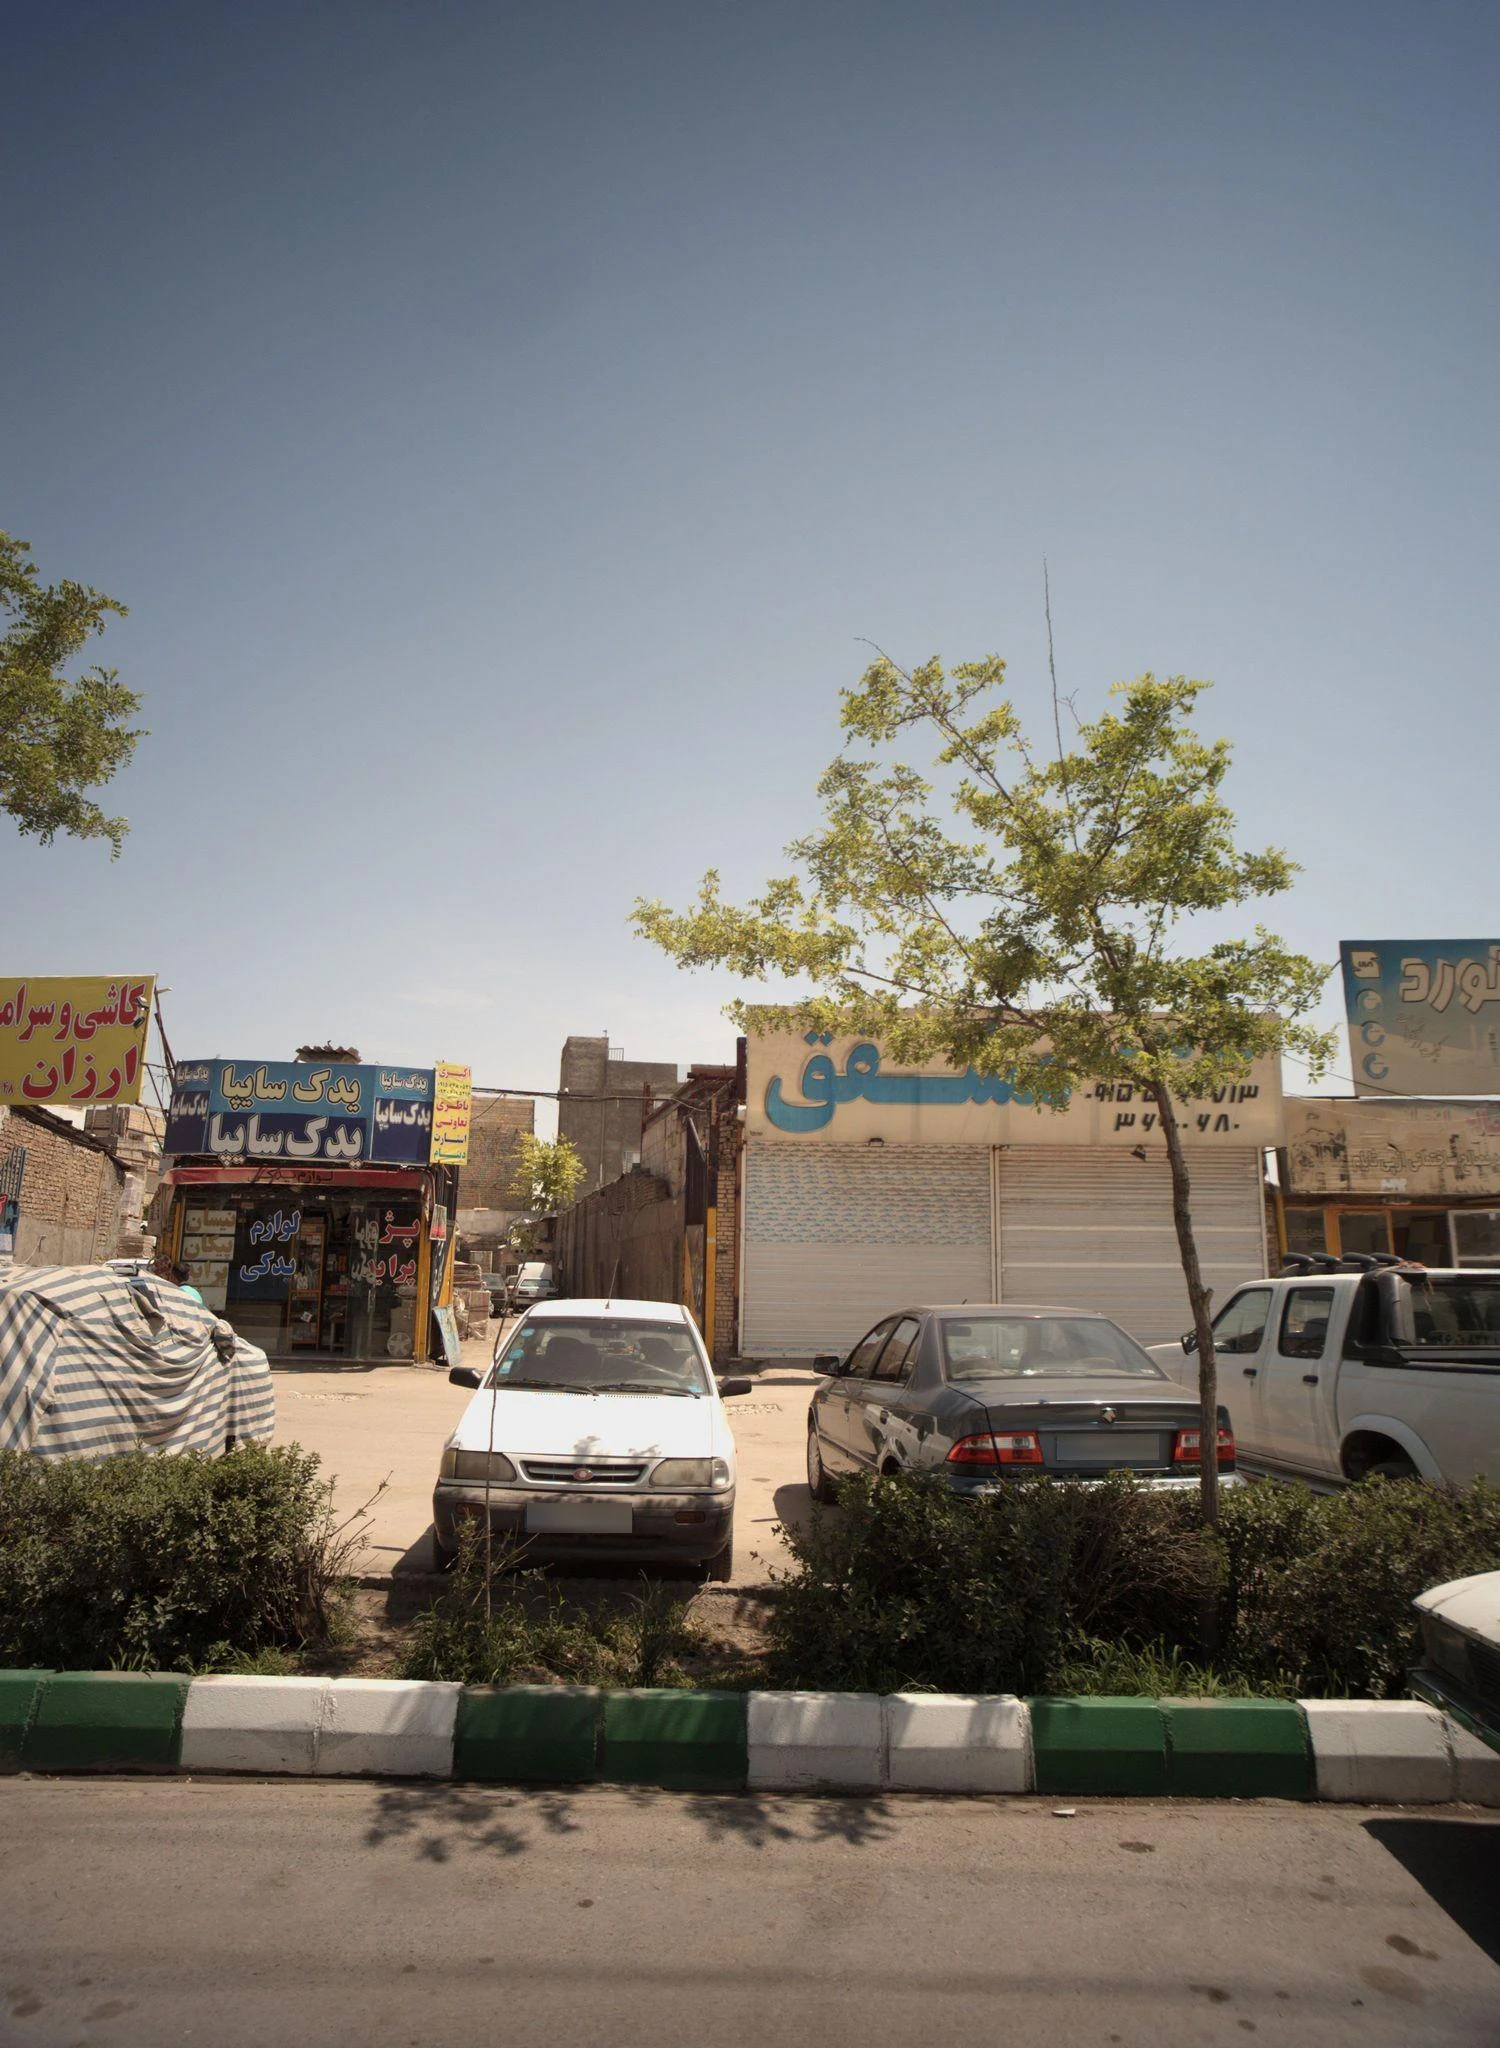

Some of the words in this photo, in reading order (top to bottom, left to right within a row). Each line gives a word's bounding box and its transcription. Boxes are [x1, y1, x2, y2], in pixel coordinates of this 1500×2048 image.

[0, 982, 57, 1041] سرام
[53, 1001, 73, 1041] و
[73, 982, 146, 1041] کاشی
[22, 1044, 139, 1099] ارزان
[220, 1063, 289, 1111] سایپا
[293, 1068, 361, 1113] یدک
[380, 1071, 404, 1092] سایپا
[404, 1073, 428, 1094] یدک
[375, 1100, 404, 1131] سایپا
[404, 1103, 431, 1131] یدک
[210, 1113, 285, 1167] سایپا
[285, 1116, 363, 1168] یدک
[186, 1207, 236, 1233] نیسان
[250, 1209, 301, 1245] لوازم
[184, 1234, 233, 1260] پیکان
[240, 1251, 297, 1283] یدکی
